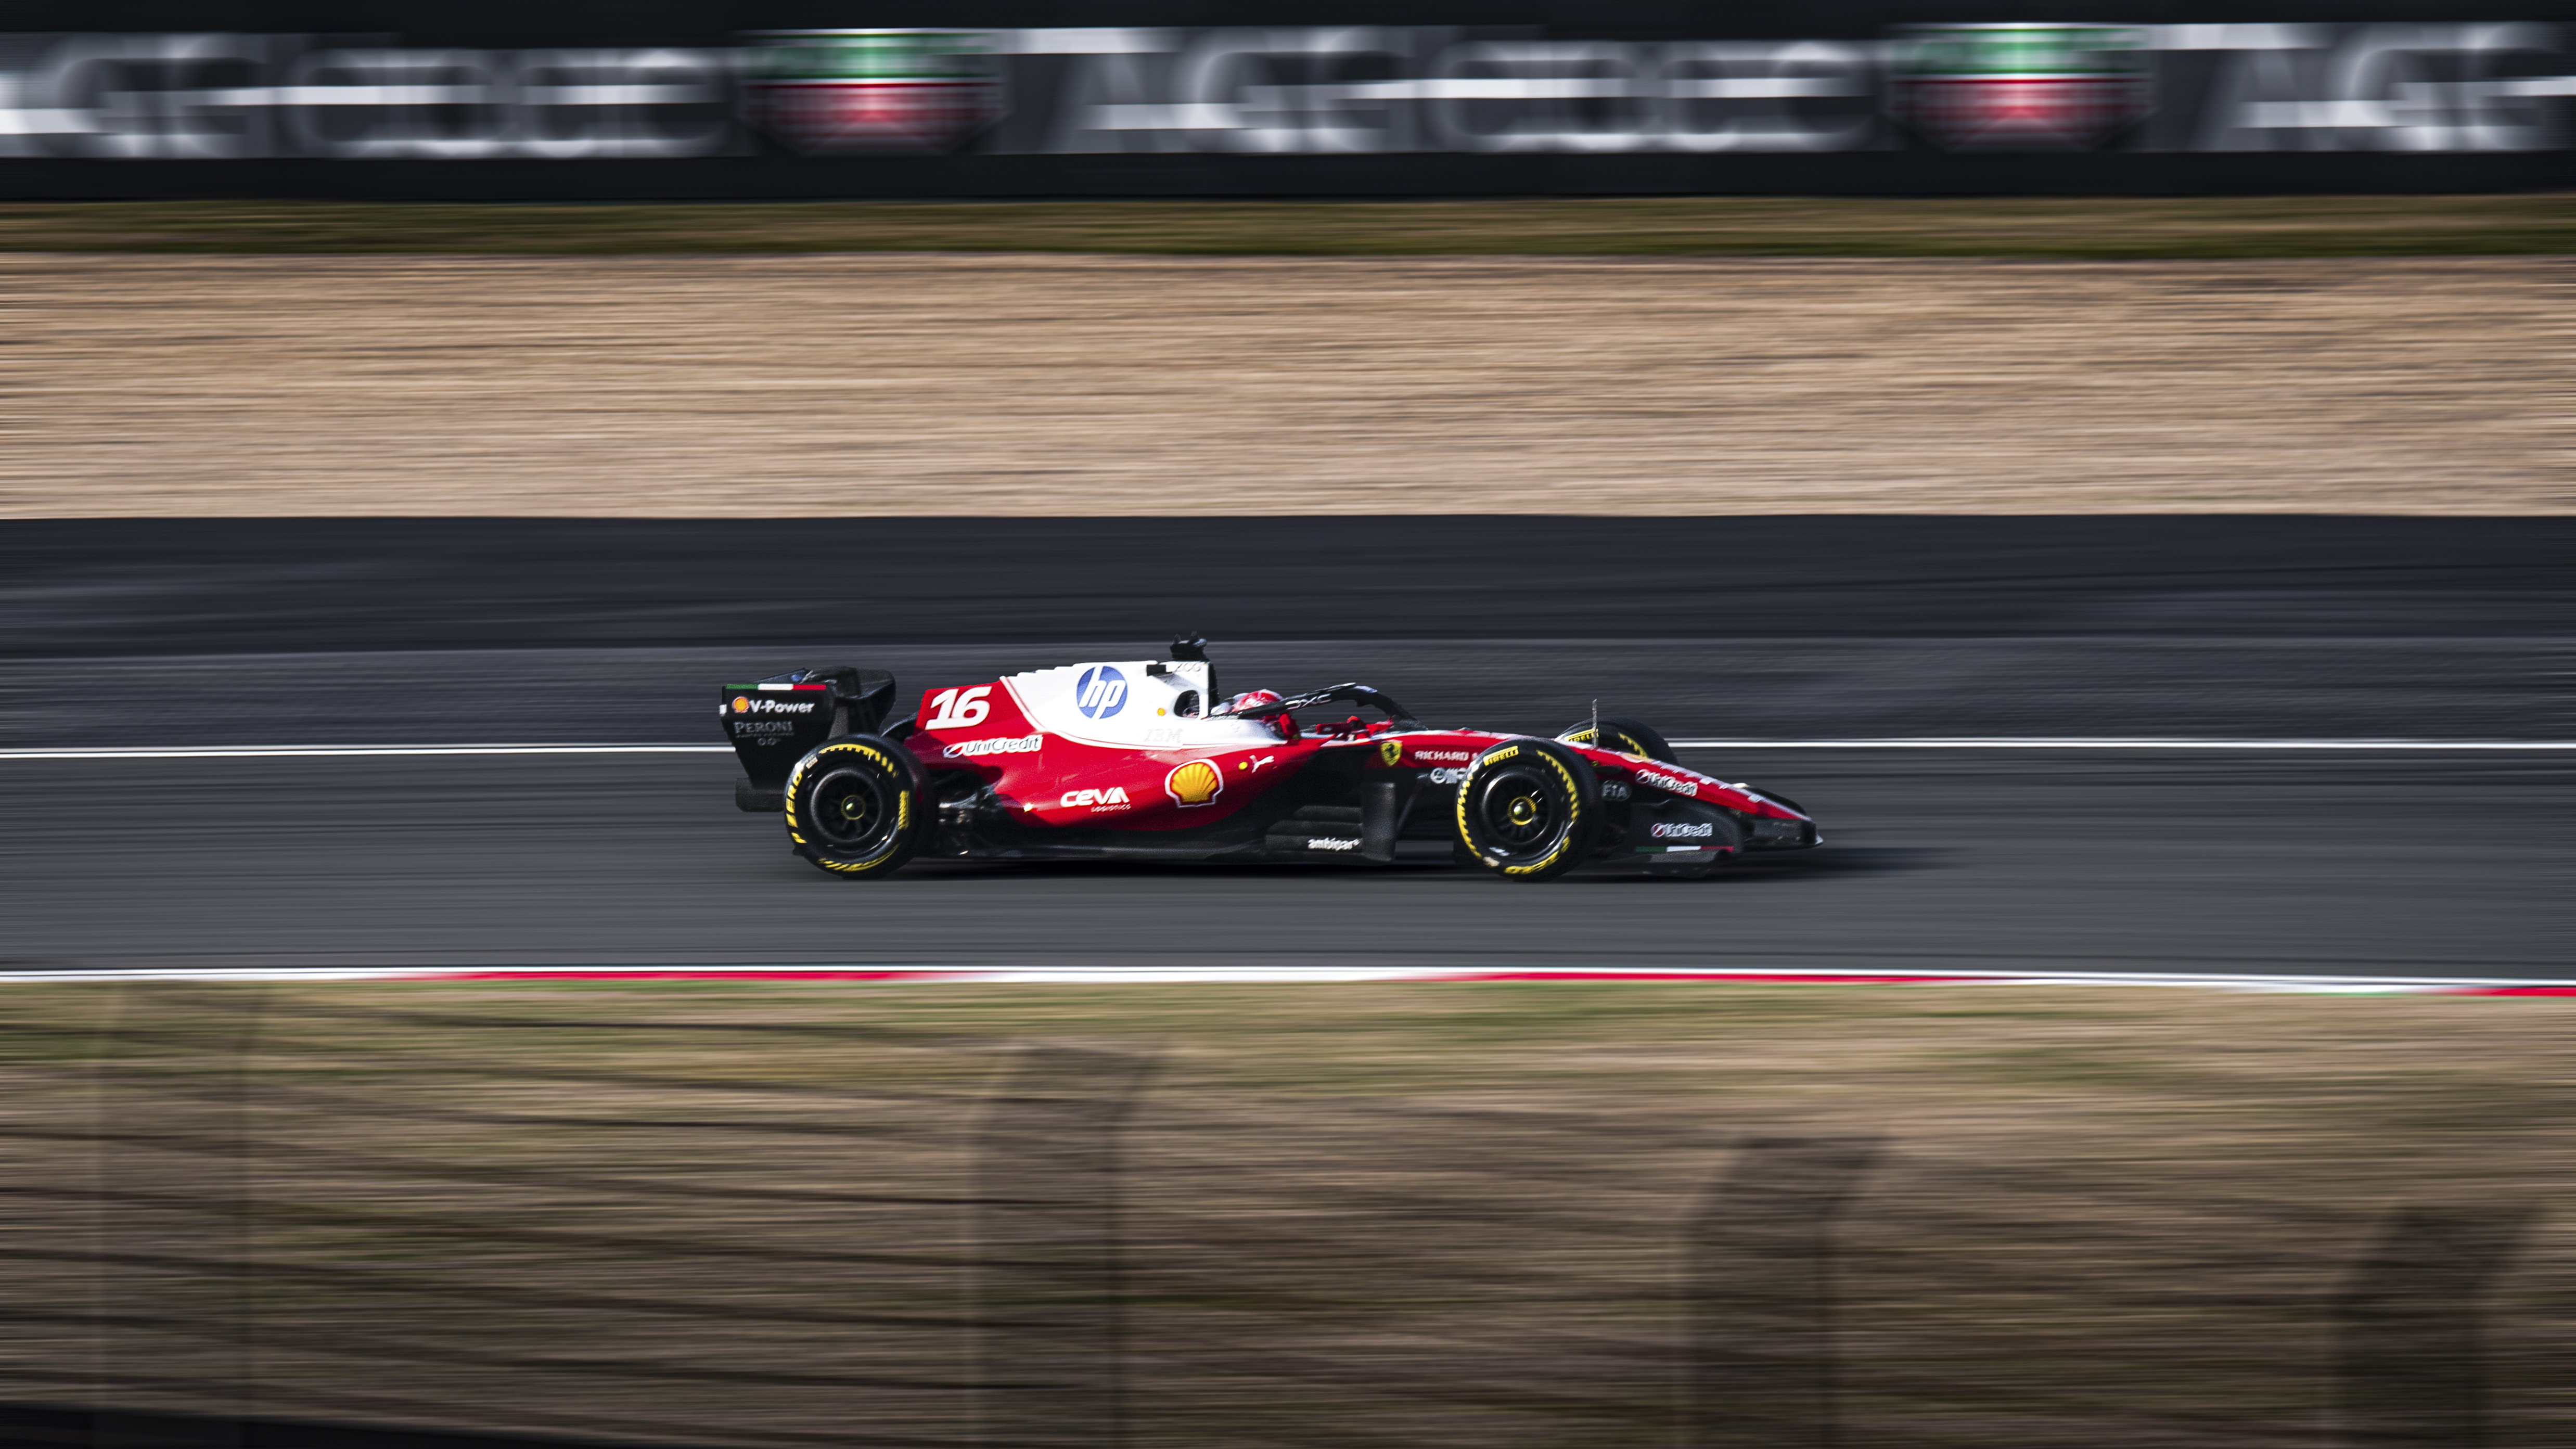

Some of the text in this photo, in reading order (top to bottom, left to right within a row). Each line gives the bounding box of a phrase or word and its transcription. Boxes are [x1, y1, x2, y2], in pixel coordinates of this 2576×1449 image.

[1078, 666, 1126, 719] hp
[749, 700, 814, 713] V-Power
[925, 686, 992, 730] 16
[734, 721, 793, 733] PERONI
[965, 736, 1042, 754] UniCredit
[1415, 751, 1469, 761] RICHARD
[1483, 746, 1519, 766] PIRELLI
[1060, 787, 1130, 807] CEVA
